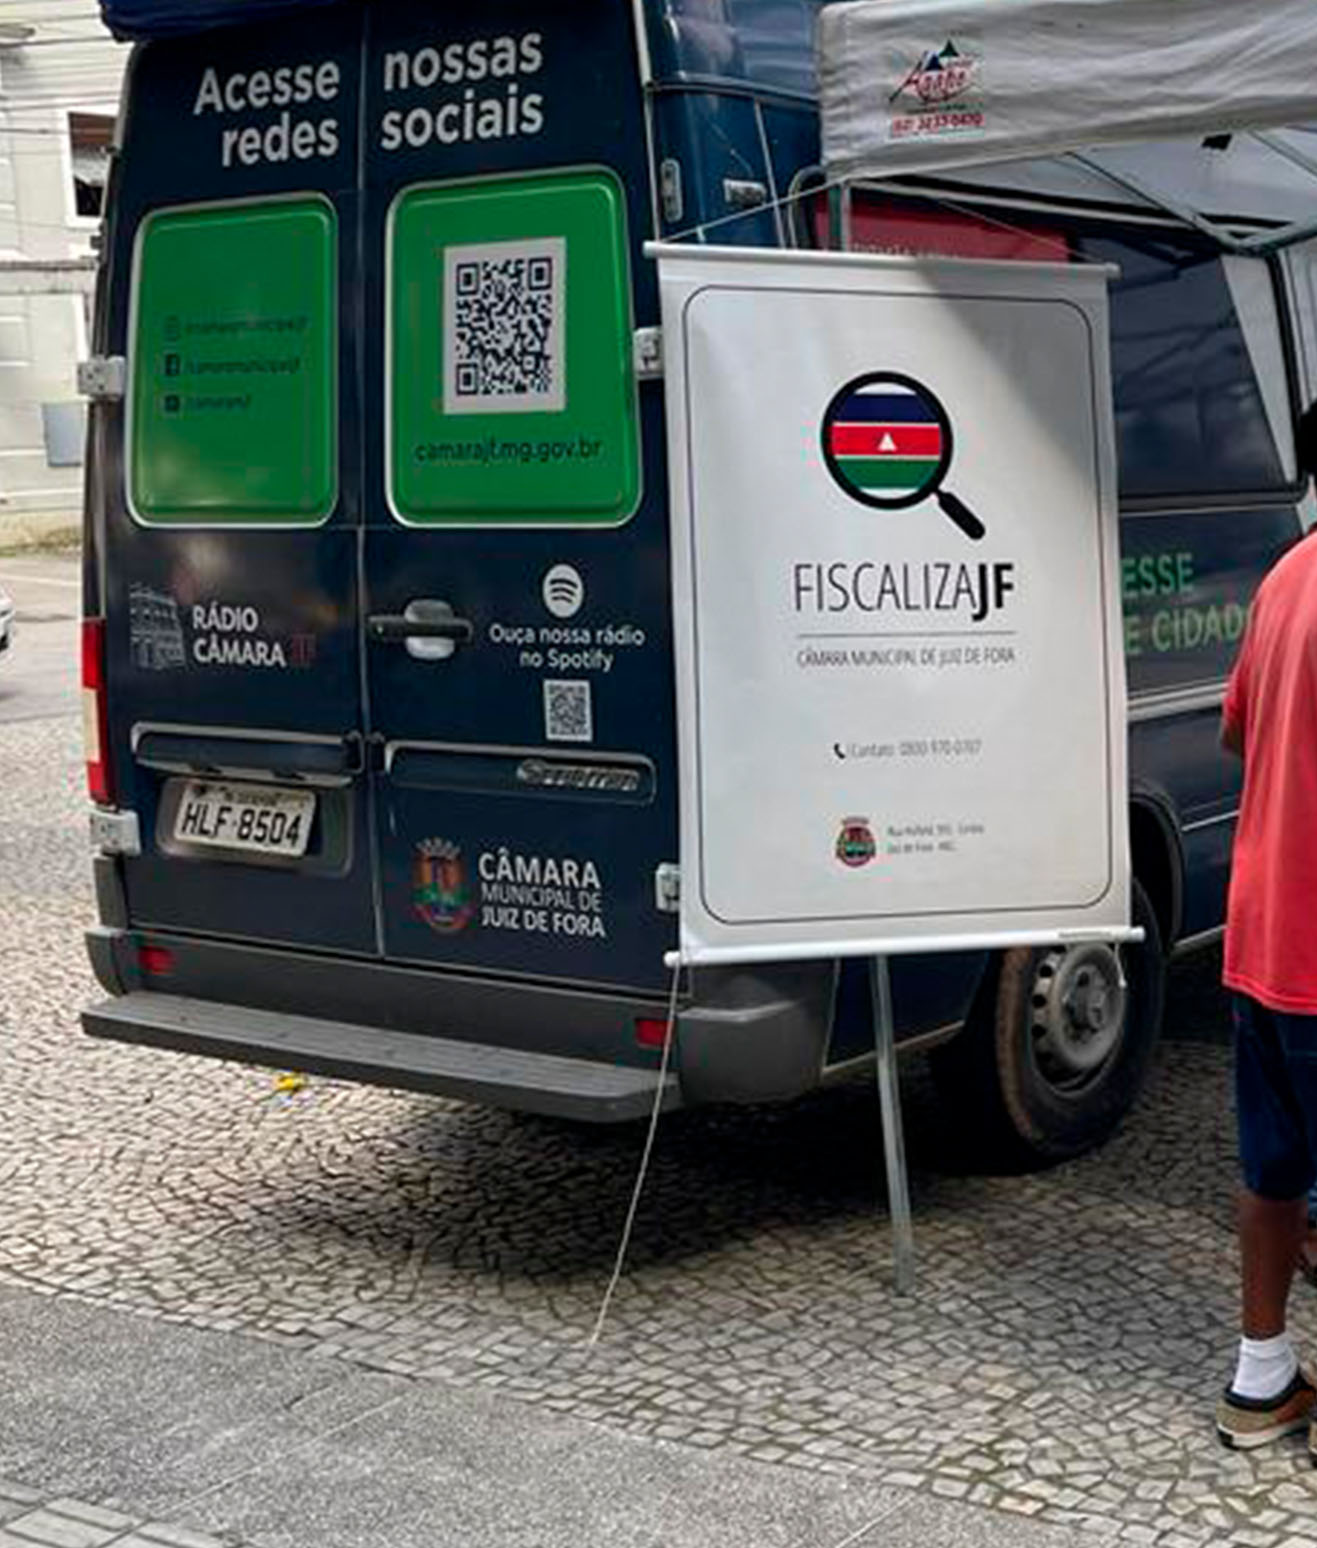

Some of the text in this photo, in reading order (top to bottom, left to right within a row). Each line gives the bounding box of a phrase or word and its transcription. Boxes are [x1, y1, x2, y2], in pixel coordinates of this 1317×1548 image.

[193, 32, 543, 115] Acesse nossas
[222, 83, 544, 167] redes sociais
[794, 562, 1014, 621] FISCALIZAJF
[193, 601, 258, 632] RÁDIO
[193, 633, 287, 667] CÂMARA
[489, 623, 646, 645] Ouça nossa rádio
[519, 647, 614, 673] no Spotify
[797, 646, 848, 667] CÂMARA
[851, 649, 915, 666] MUNICIPAL
[921, 649, 936, 665] DE
[964, 647, 981, 665] DE
[984, 646, 1015, 664] FORA
[478, 846, 601, 889] CÂMARA
[480, 882, 602, 912] MUNICIPAL DE
[481, 906, 606, 938] JUIZ DE FORA
